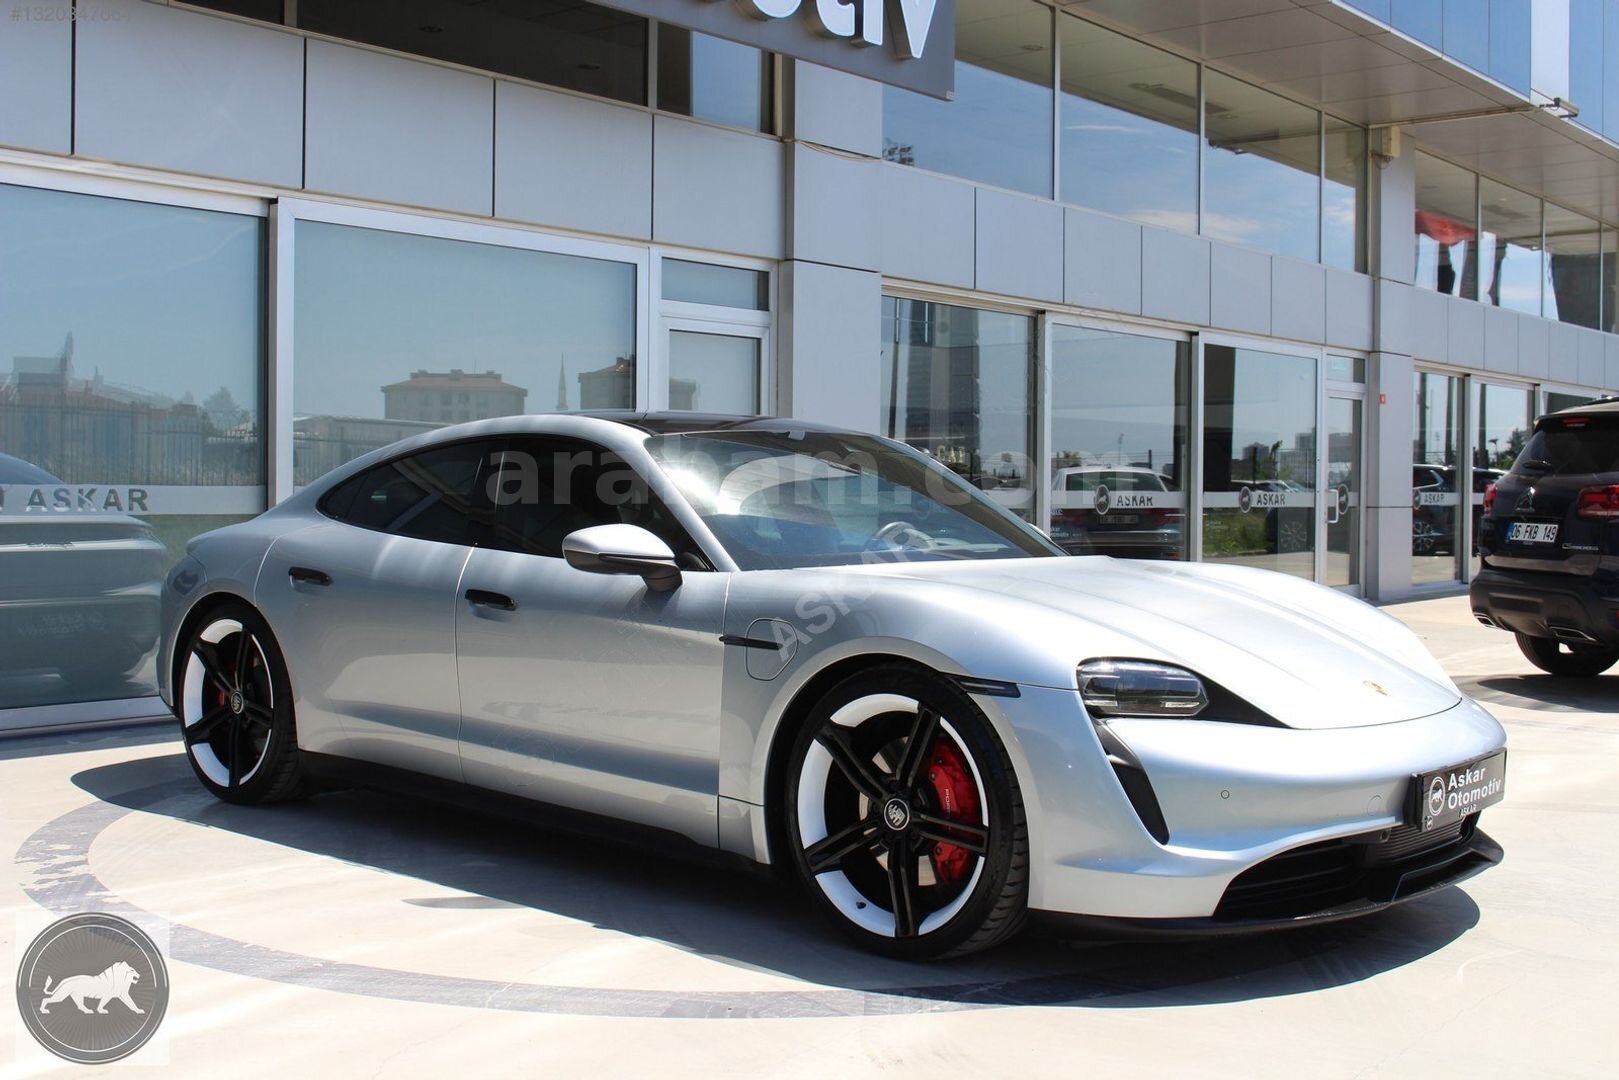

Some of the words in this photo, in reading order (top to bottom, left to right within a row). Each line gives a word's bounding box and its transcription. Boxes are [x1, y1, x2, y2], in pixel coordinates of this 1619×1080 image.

[26, 488, 149, 512] ASKAR
[1117, 495, 1154, 507] ASKAR
[1256, 493, 1286, 506] ASKAR
[1448, 767, 1486, 791] Askar
[1448, 778, 1502, 809] Otomotiv
